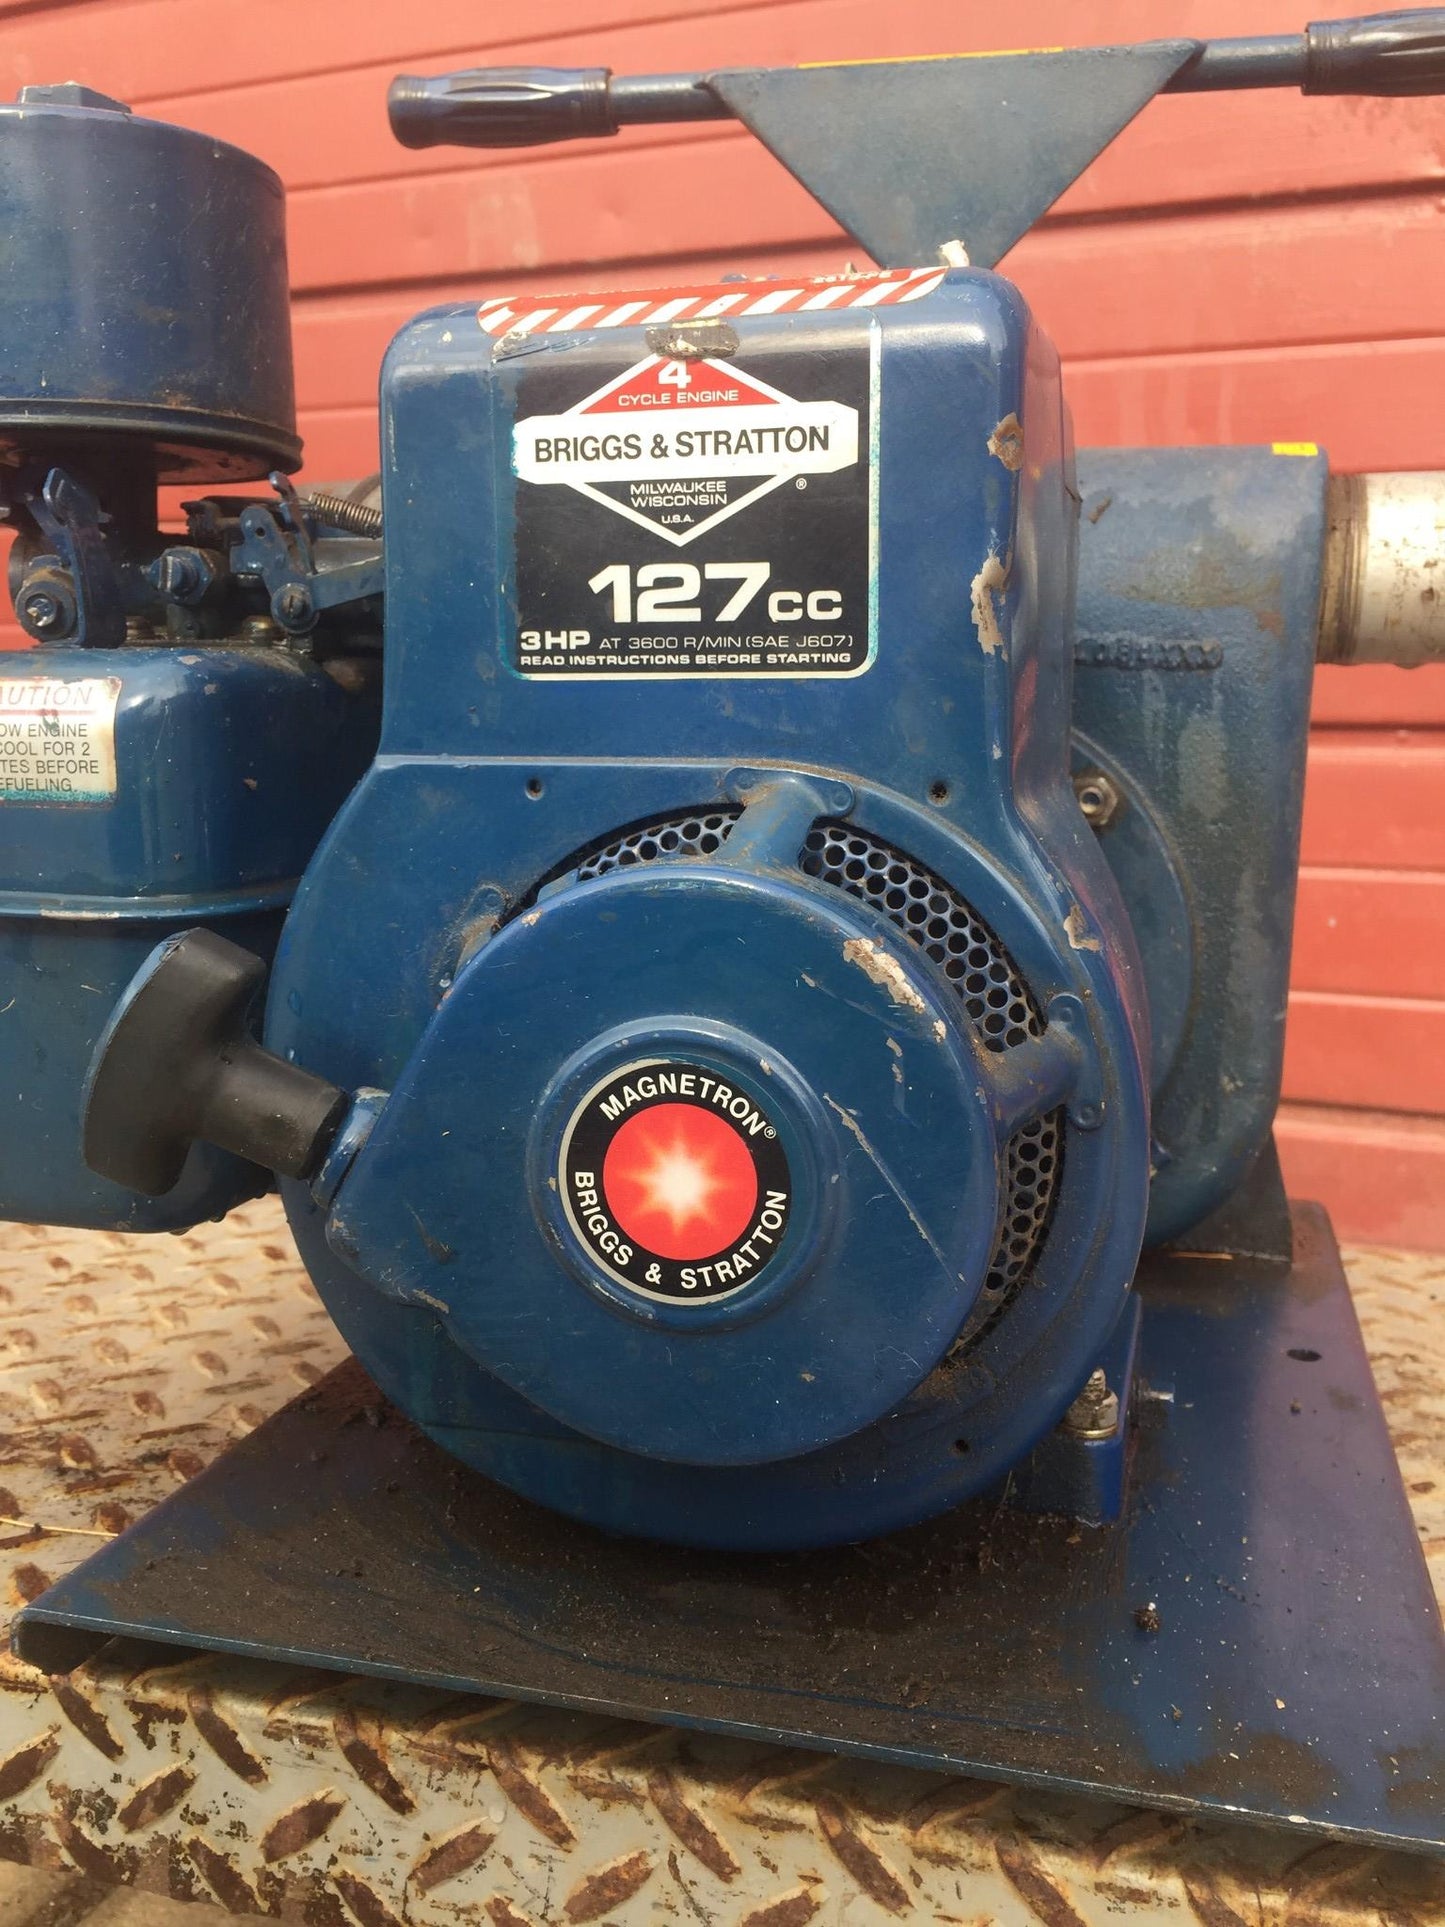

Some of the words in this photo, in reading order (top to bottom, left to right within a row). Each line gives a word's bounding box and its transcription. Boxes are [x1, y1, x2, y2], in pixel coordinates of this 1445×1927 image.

[658, 358, 692, 389] 4
[618, 392, 671, 406] CYCLE
[676, 389, 739, 404] ENGINE
[534, 435, 641, 463] BRIGGS
[650, 434, 670, 459] &
[675, 425, 830, 458] STRATTON
[630, 481, 727, 495] MILWAUKEE
[631, 493, 727, 507] WISCONSIN
[661, 514, 695, 524] U.S.A.
[600, 637, 626, 650] AT
[628, 636, 678, 650] 3600
[684, 636, 742, 652] R/MIN
[745, 635, 788, 649] (SAE
[795, 634, 854, 649] J607)
[520, 654, 564, 666] READ
[569, 653, 690, 666] INSTRUCTIONS
[695, 653, 761, 665] BEFORE
[766, 651, 852, 664] STARTING
[0, 685, 93, 705] UTION
[28, 723, 87, 738] ENGINE
[0, 741, 38, 756] OOL
[43, 741, 75, 756] FOR
[82, 742, 90, 756] 2
[36, 759, 100, 775] BEFORE
[575, 1171, 633, 1266] BRIGGS
[644, 1262, 662, 1285] &
[680, 1190, 788, 1290] STRATTON
